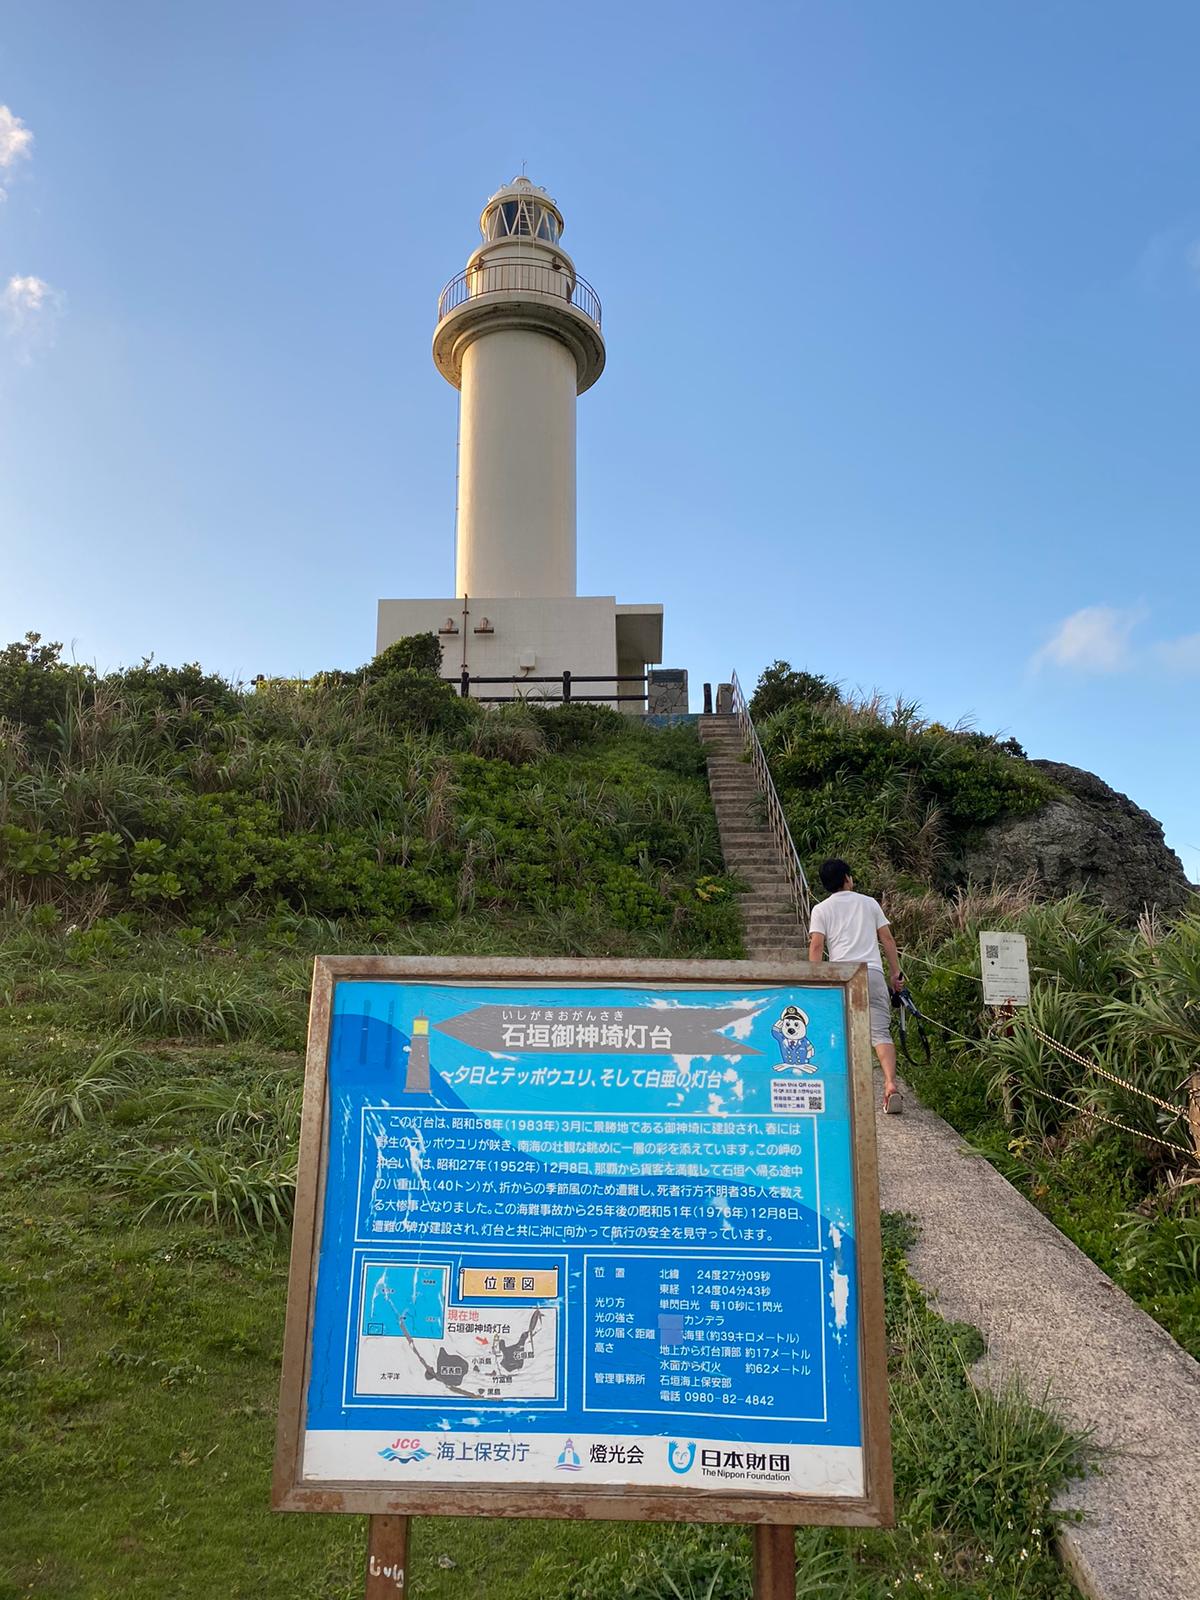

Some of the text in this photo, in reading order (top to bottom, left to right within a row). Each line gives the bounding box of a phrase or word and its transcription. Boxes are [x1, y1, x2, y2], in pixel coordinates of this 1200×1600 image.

[659, 1269, 770, 1282] 北緯 24度27分09秒
[484, 1276, 535, 1291] 位置図
[659, 1284, 770, 1297] 東経 124度04分43秒
[595, 1297, 625, 1308] 光り方
[659, 1299, 783, 1313] 単閃白光 毎10秒に1閃光
[448, 1309, 479, 1321] 現在地
[595, 1312, 634, 1324] 光の強さ
[595, 1328, 656, 1339] 光の届く距離
[594, 1342, 614, 1353] 高さ
[659, 1345, 811, 1360] 地上から灯台頂部 約17メートル
[659, 1361, 811, 1376] 水面から灯火 約62メートル
[594, 1372, 646, 1385] 管理事務所
[659, 1376, 732, 1389] 石垣海上保安部
[659, 1390, 680, 1402] 電話
[392, 1438, 421, 1450] JCG
[437, 1441, 530, 1462] 海上保安庁
[589, 1444, 644, 1464] 燈光会
[701, 1450, 790, 1471] 日本財団
[702, 1468, 790, 1481] The Nippon Foundation
